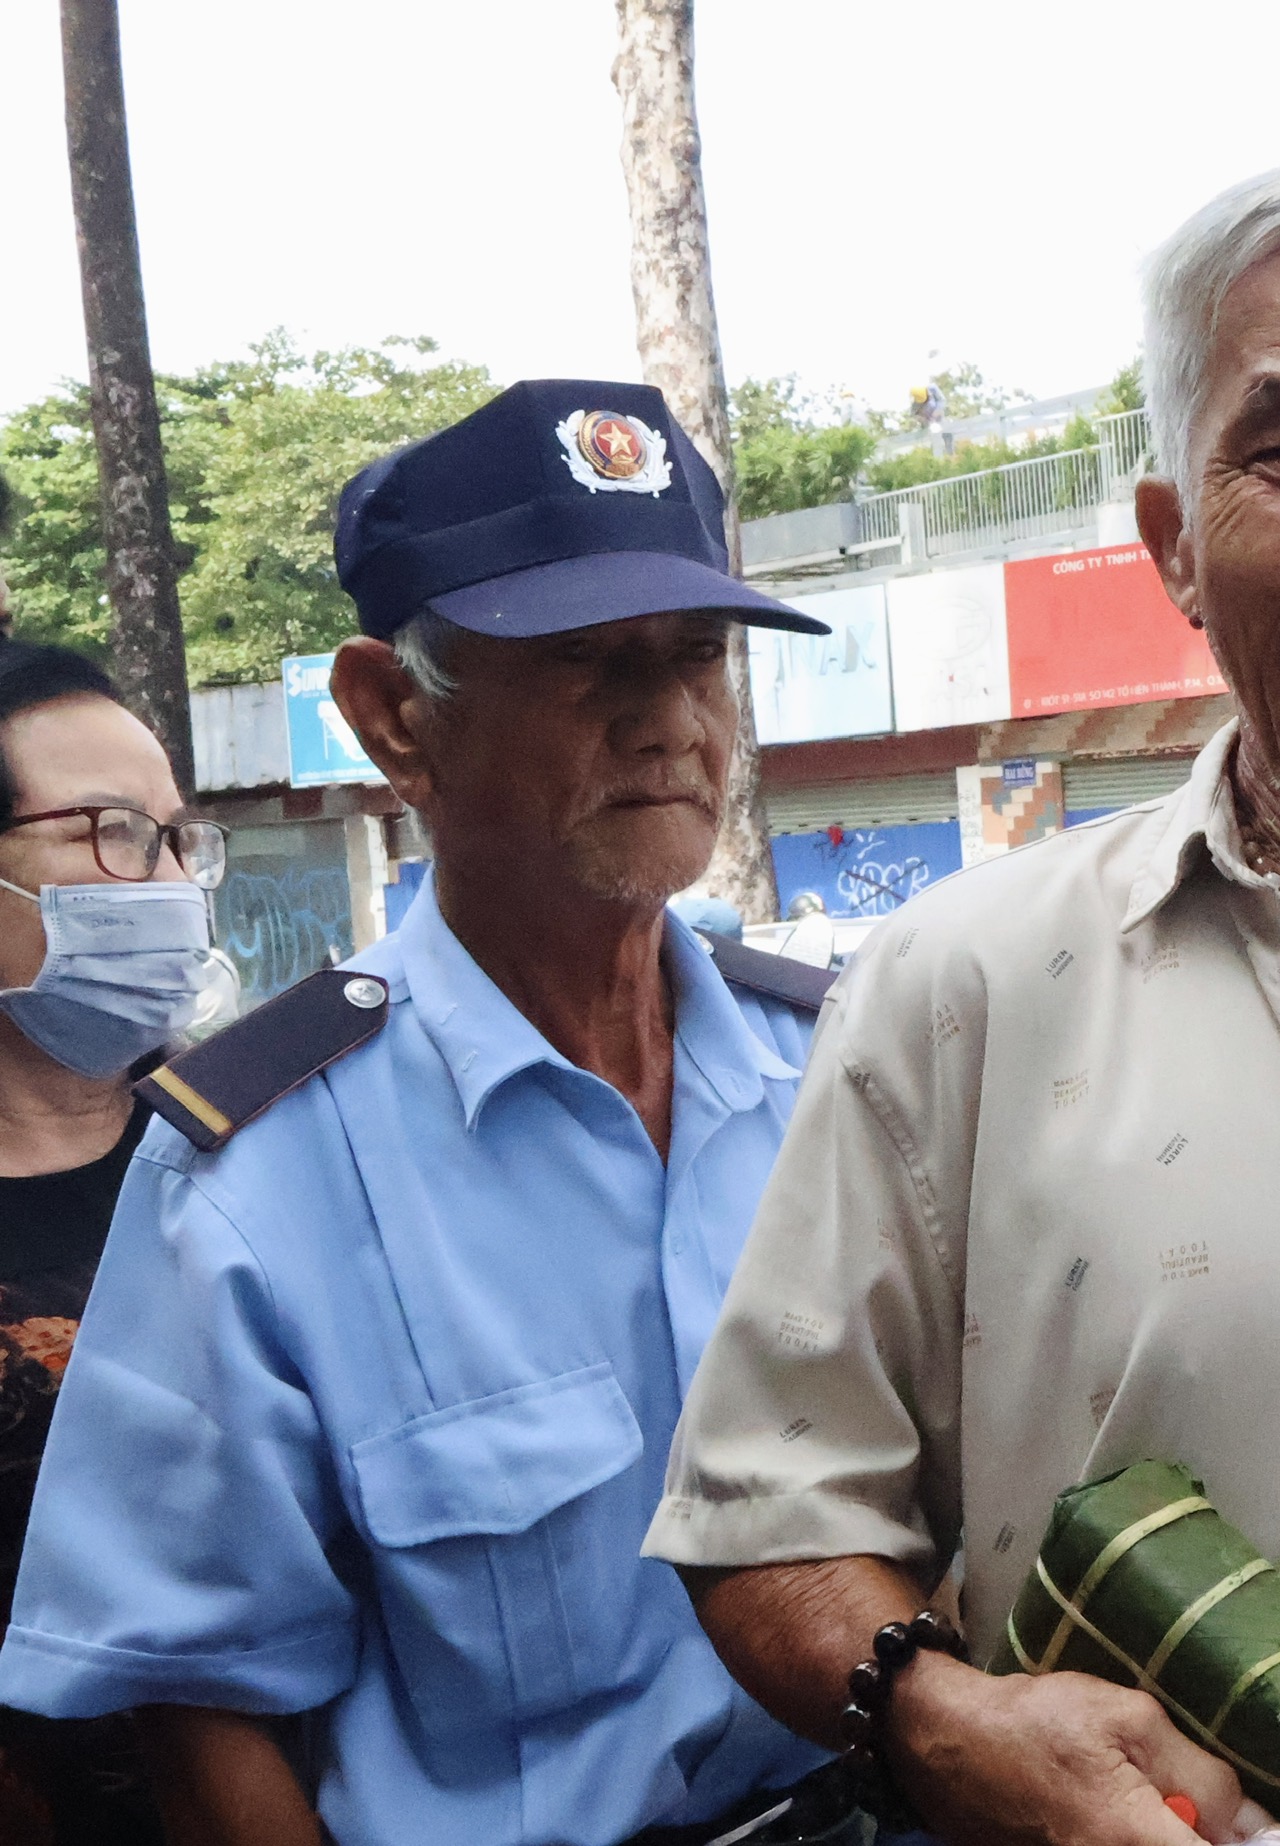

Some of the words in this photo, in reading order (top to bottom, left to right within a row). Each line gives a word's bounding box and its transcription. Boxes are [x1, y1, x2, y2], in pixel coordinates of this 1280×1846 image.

[1087, 556, 1103, 569] TY
[1105, 550, 1137, 566] TNHH
[1045, 949, 1068, 973] LUREN
[1163, 1137, 1189, 1166] LUREN
